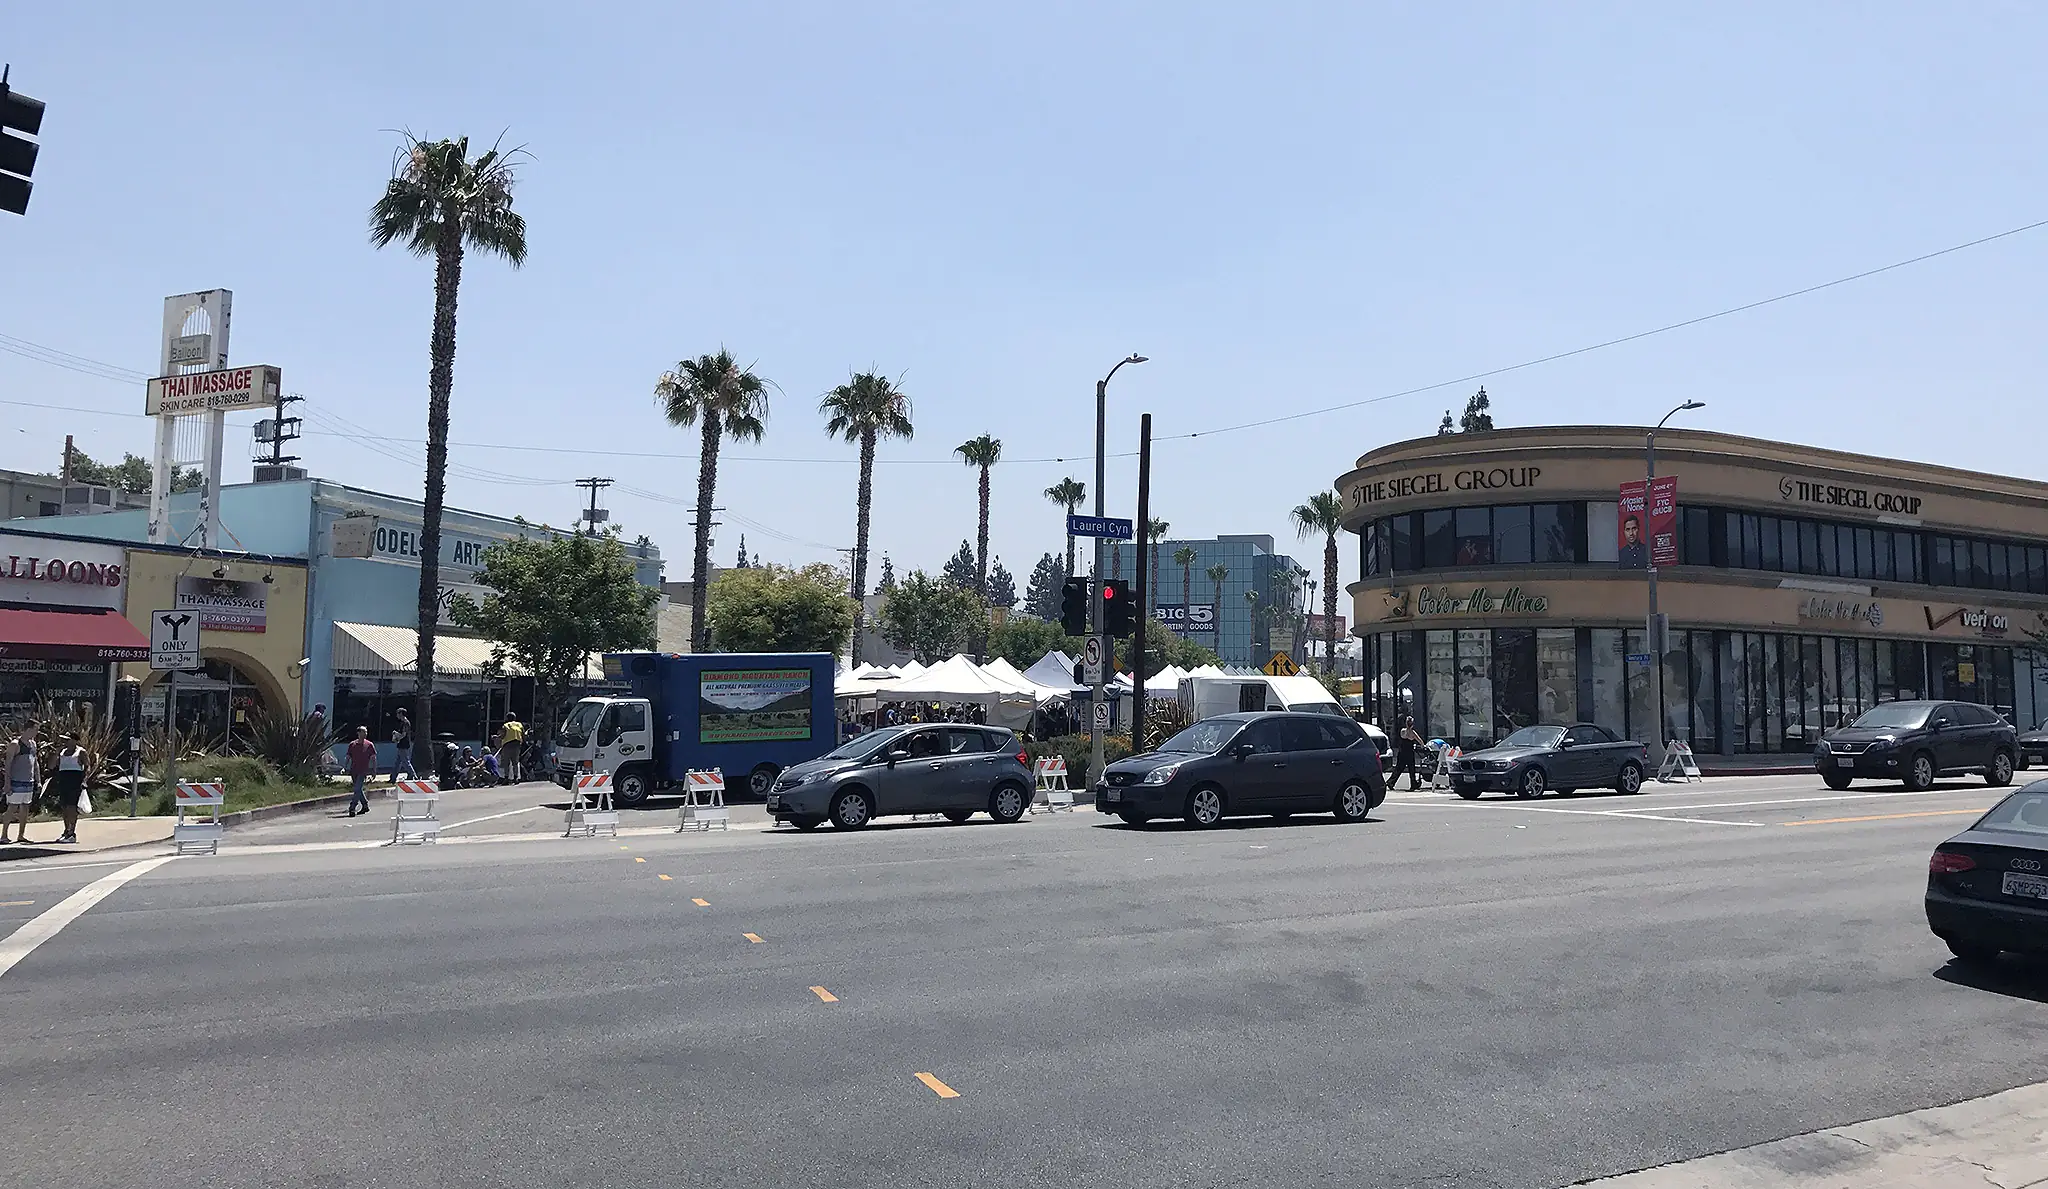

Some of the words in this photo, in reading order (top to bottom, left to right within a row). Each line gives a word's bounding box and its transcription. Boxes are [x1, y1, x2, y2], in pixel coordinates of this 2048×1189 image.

[172, 347, 201, 359] Balloon
[161, 377, 189, 398] THAI
[192, 370, 252, 395] MASSAGE
[160, 401, 179, 412] SKIN
[181, 398, 205, 409] CARE
[207, 392, 250, 406] 818-760-0299
[1360, 481, 1386, 503] THE
[1388, 473, 1449, 499] SIEGEL
[1454, 467, 1541, 491] GROUP
[1657, 498, 1670, 507] FYC
[1796, 481, 1824, 503] THE
[1826, 485, 1872, 509] SIEGEL
[1874, 492, 1922, 515] GROUP
[1627, 503, 1645, 512] None
[1652, 506, 1673, 517] @UCB
[1072, 519, 1106, 532] Laurel
[1108, 523, 1129, 536] Cyn
[376, 527, 424, 557] ODEL
[453, 540, 482, 566] ART
[180, 594, 209, 605] THAI
[212, 597, 265, 609] MASSAGE
[1417, 586, 1461, 614] Color
[1466, 587, 1493, 614] Me
[1500, 586, 1547, 614] Mine
[202, 614, 251, 624] 8-760-0299
[1155, 608, 1184, 619] BIG
[1189, 605, 1214, 622] 5
[1962, 609, 2008, 629] verion
[162, 641, 188, 651] ONLY
[231, 696, 254, 707] OPEN
